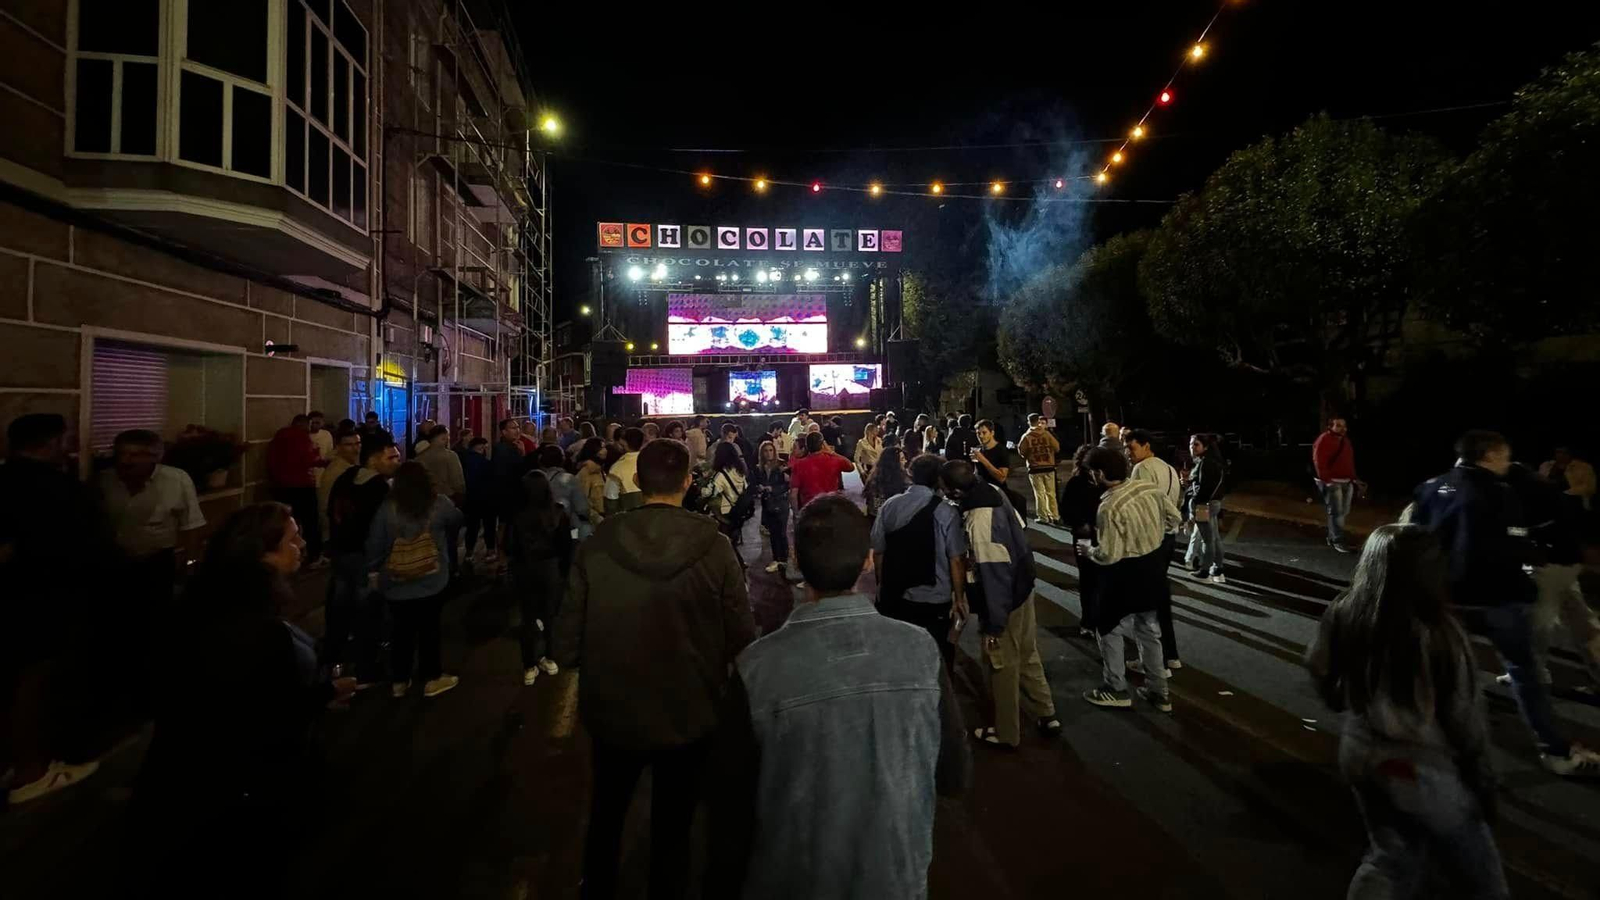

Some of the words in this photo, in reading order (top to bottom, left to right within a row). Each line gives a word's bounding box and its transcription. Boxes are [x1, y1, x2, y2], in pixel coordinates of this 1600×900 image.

[630, 226, 876, 249] CHOCOLATE
[626, 256, 769, 268] CHOCOLATE
[780, 259, 804, 269] SE
[816, 260, 888, 269] MUEVE
